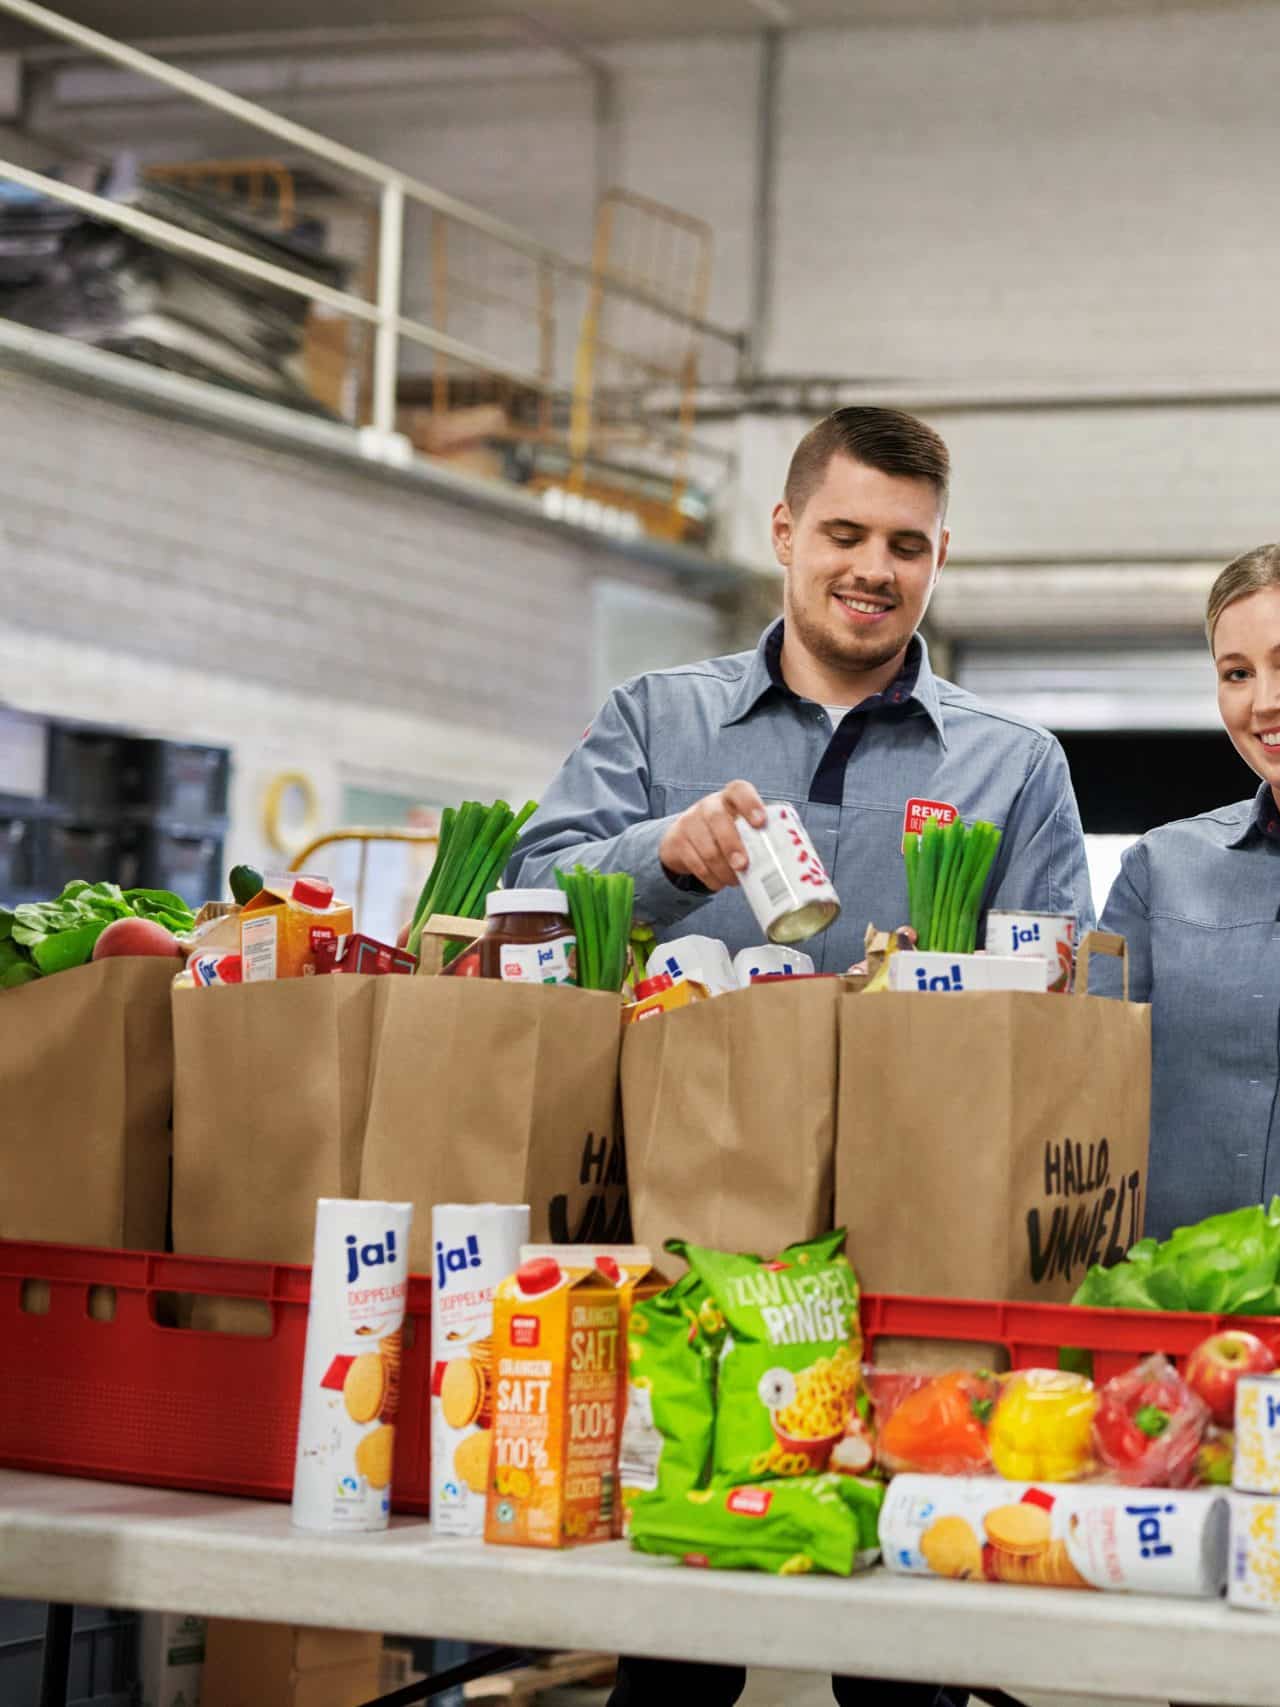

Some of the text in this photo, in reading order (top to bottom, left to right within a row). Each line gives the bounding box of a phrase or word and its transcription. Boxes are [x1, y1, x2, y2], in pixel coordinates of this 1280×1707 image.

[912, 805, 953, 822] REWE
[1011, 923, 1041, 951] ja!
[537, 950, 554, 966] ja!
[1044, 1137, 1110, 1197] HALLO,
[345, 1230, 397, 1283] ja!
[436, 1235, 482, 1290] ja!
[761, 1299, 848, 1345] RINGE
[570, 1330, 618, 1371] SAFT
[497, 1379, 551, 1413] SAFT
[495, 1437, 549, 1469] 100%
[1123, 1503, 1177, 1559] ja!
